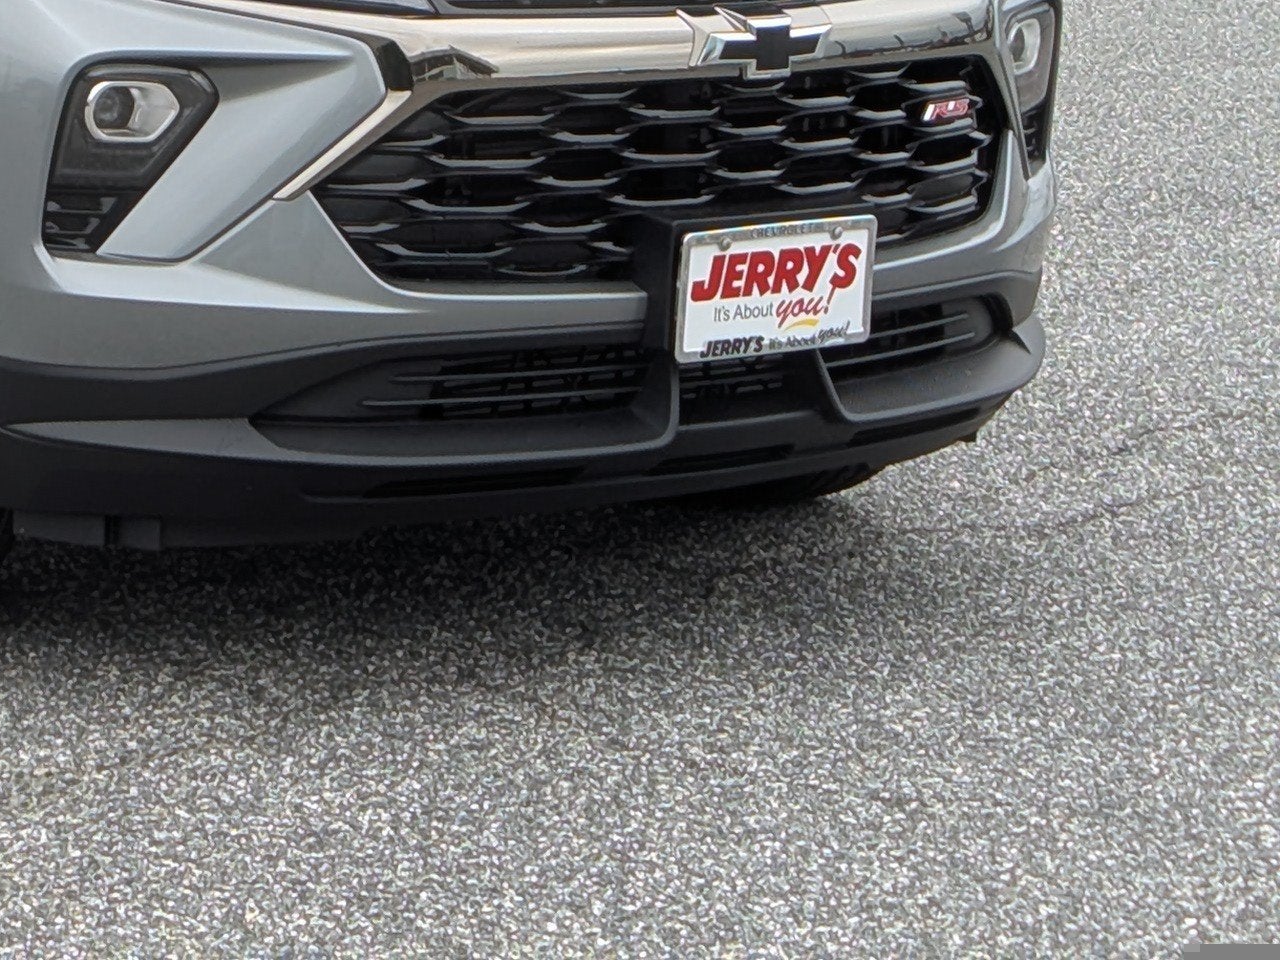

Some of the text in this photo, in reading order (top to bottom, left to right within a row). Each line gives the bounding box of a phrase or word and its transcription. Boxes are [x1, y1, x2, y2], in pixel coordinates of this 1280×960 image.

[690, 243, 862, 302] JERRY'S
[714, 286, 834, 330] It's About you!
[700, 334, 765, 359] JERRY'S
[816, 319, 851, 343] you!
